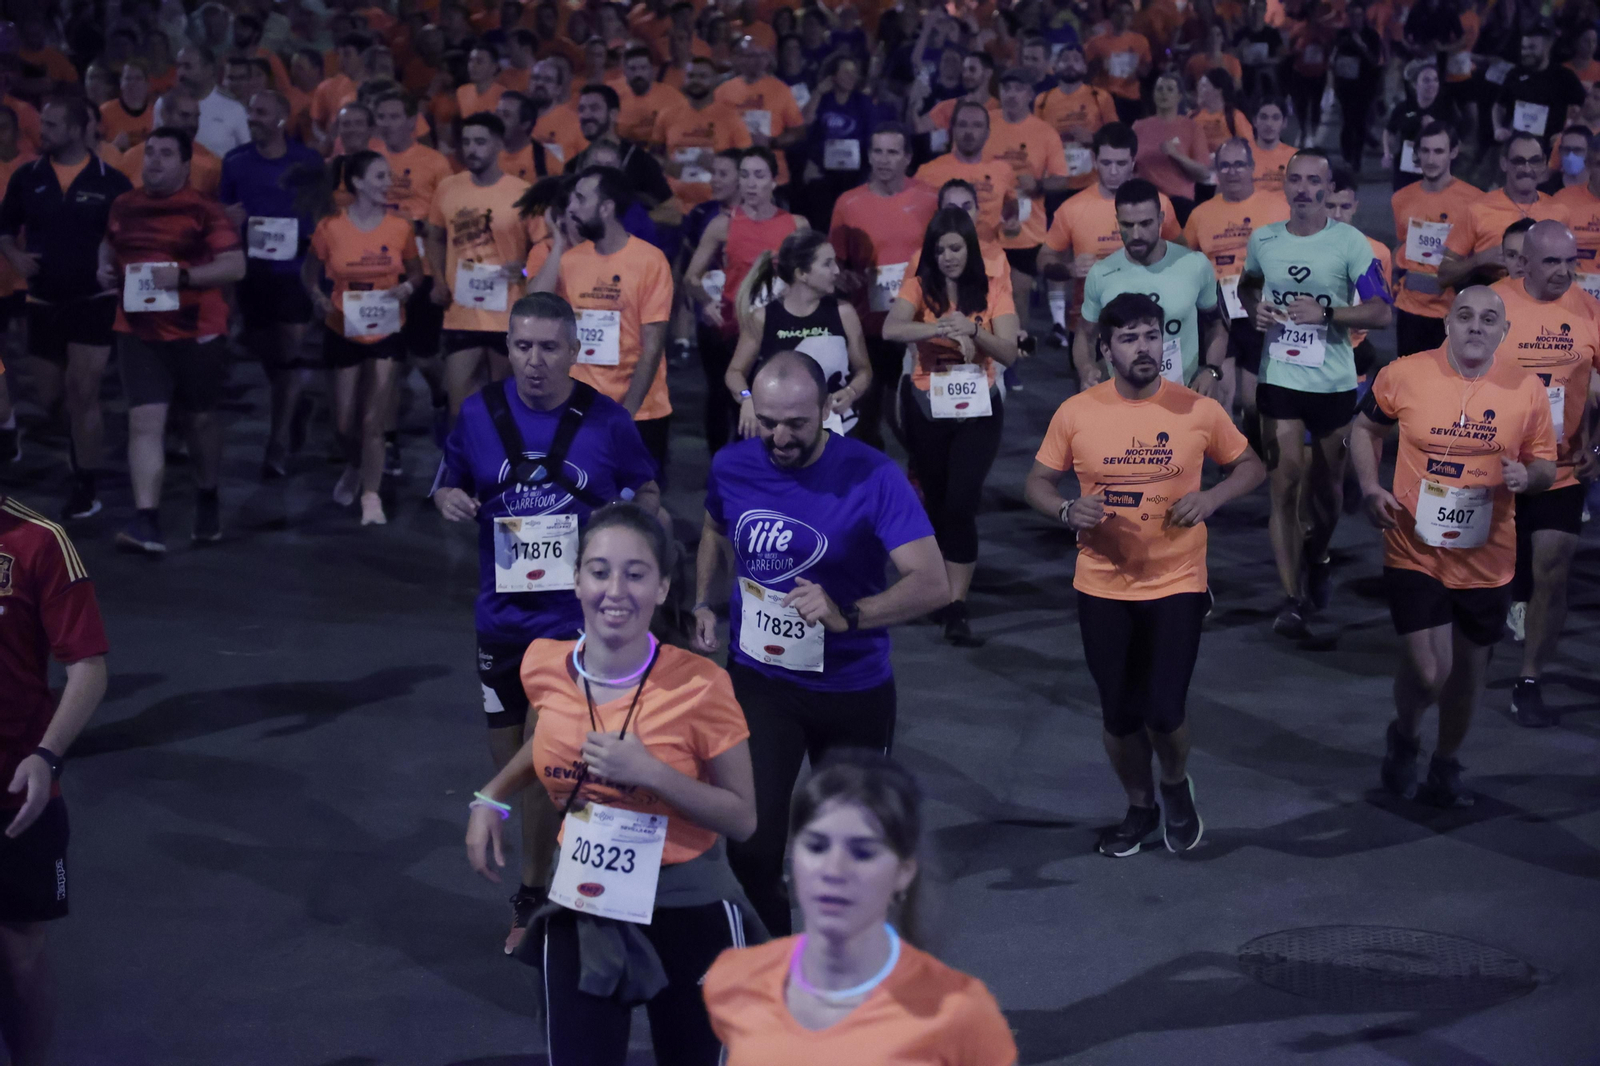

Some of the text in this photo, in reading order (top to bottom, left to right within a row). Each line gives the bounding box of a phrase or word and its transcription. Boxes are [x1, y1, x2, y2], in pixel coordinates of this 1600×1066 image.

[1418, 235, 1441, 248] 5899
[580, 328, 604, 342] 7292
[776, 327, 833, 339] mickey
[1281, 329, 1314, 345] 17341
[947, 382, 977, 396] 6962
[1452, 421, 1497, 433] NOCTURNA
[1103, 456, 1146, 465] SEVILLA
[509, 493, 557, 511] CARREFOUR
[1437, 506, 1475, 524] 5407
[511, 541, 562, 560] 17876
[746, 557, 794, 572] CARREFOUR
[756, 610, 805, 639] 17823
[571, 836, 636, 874] 20323
[55, 858, 66, 901] Kappa
